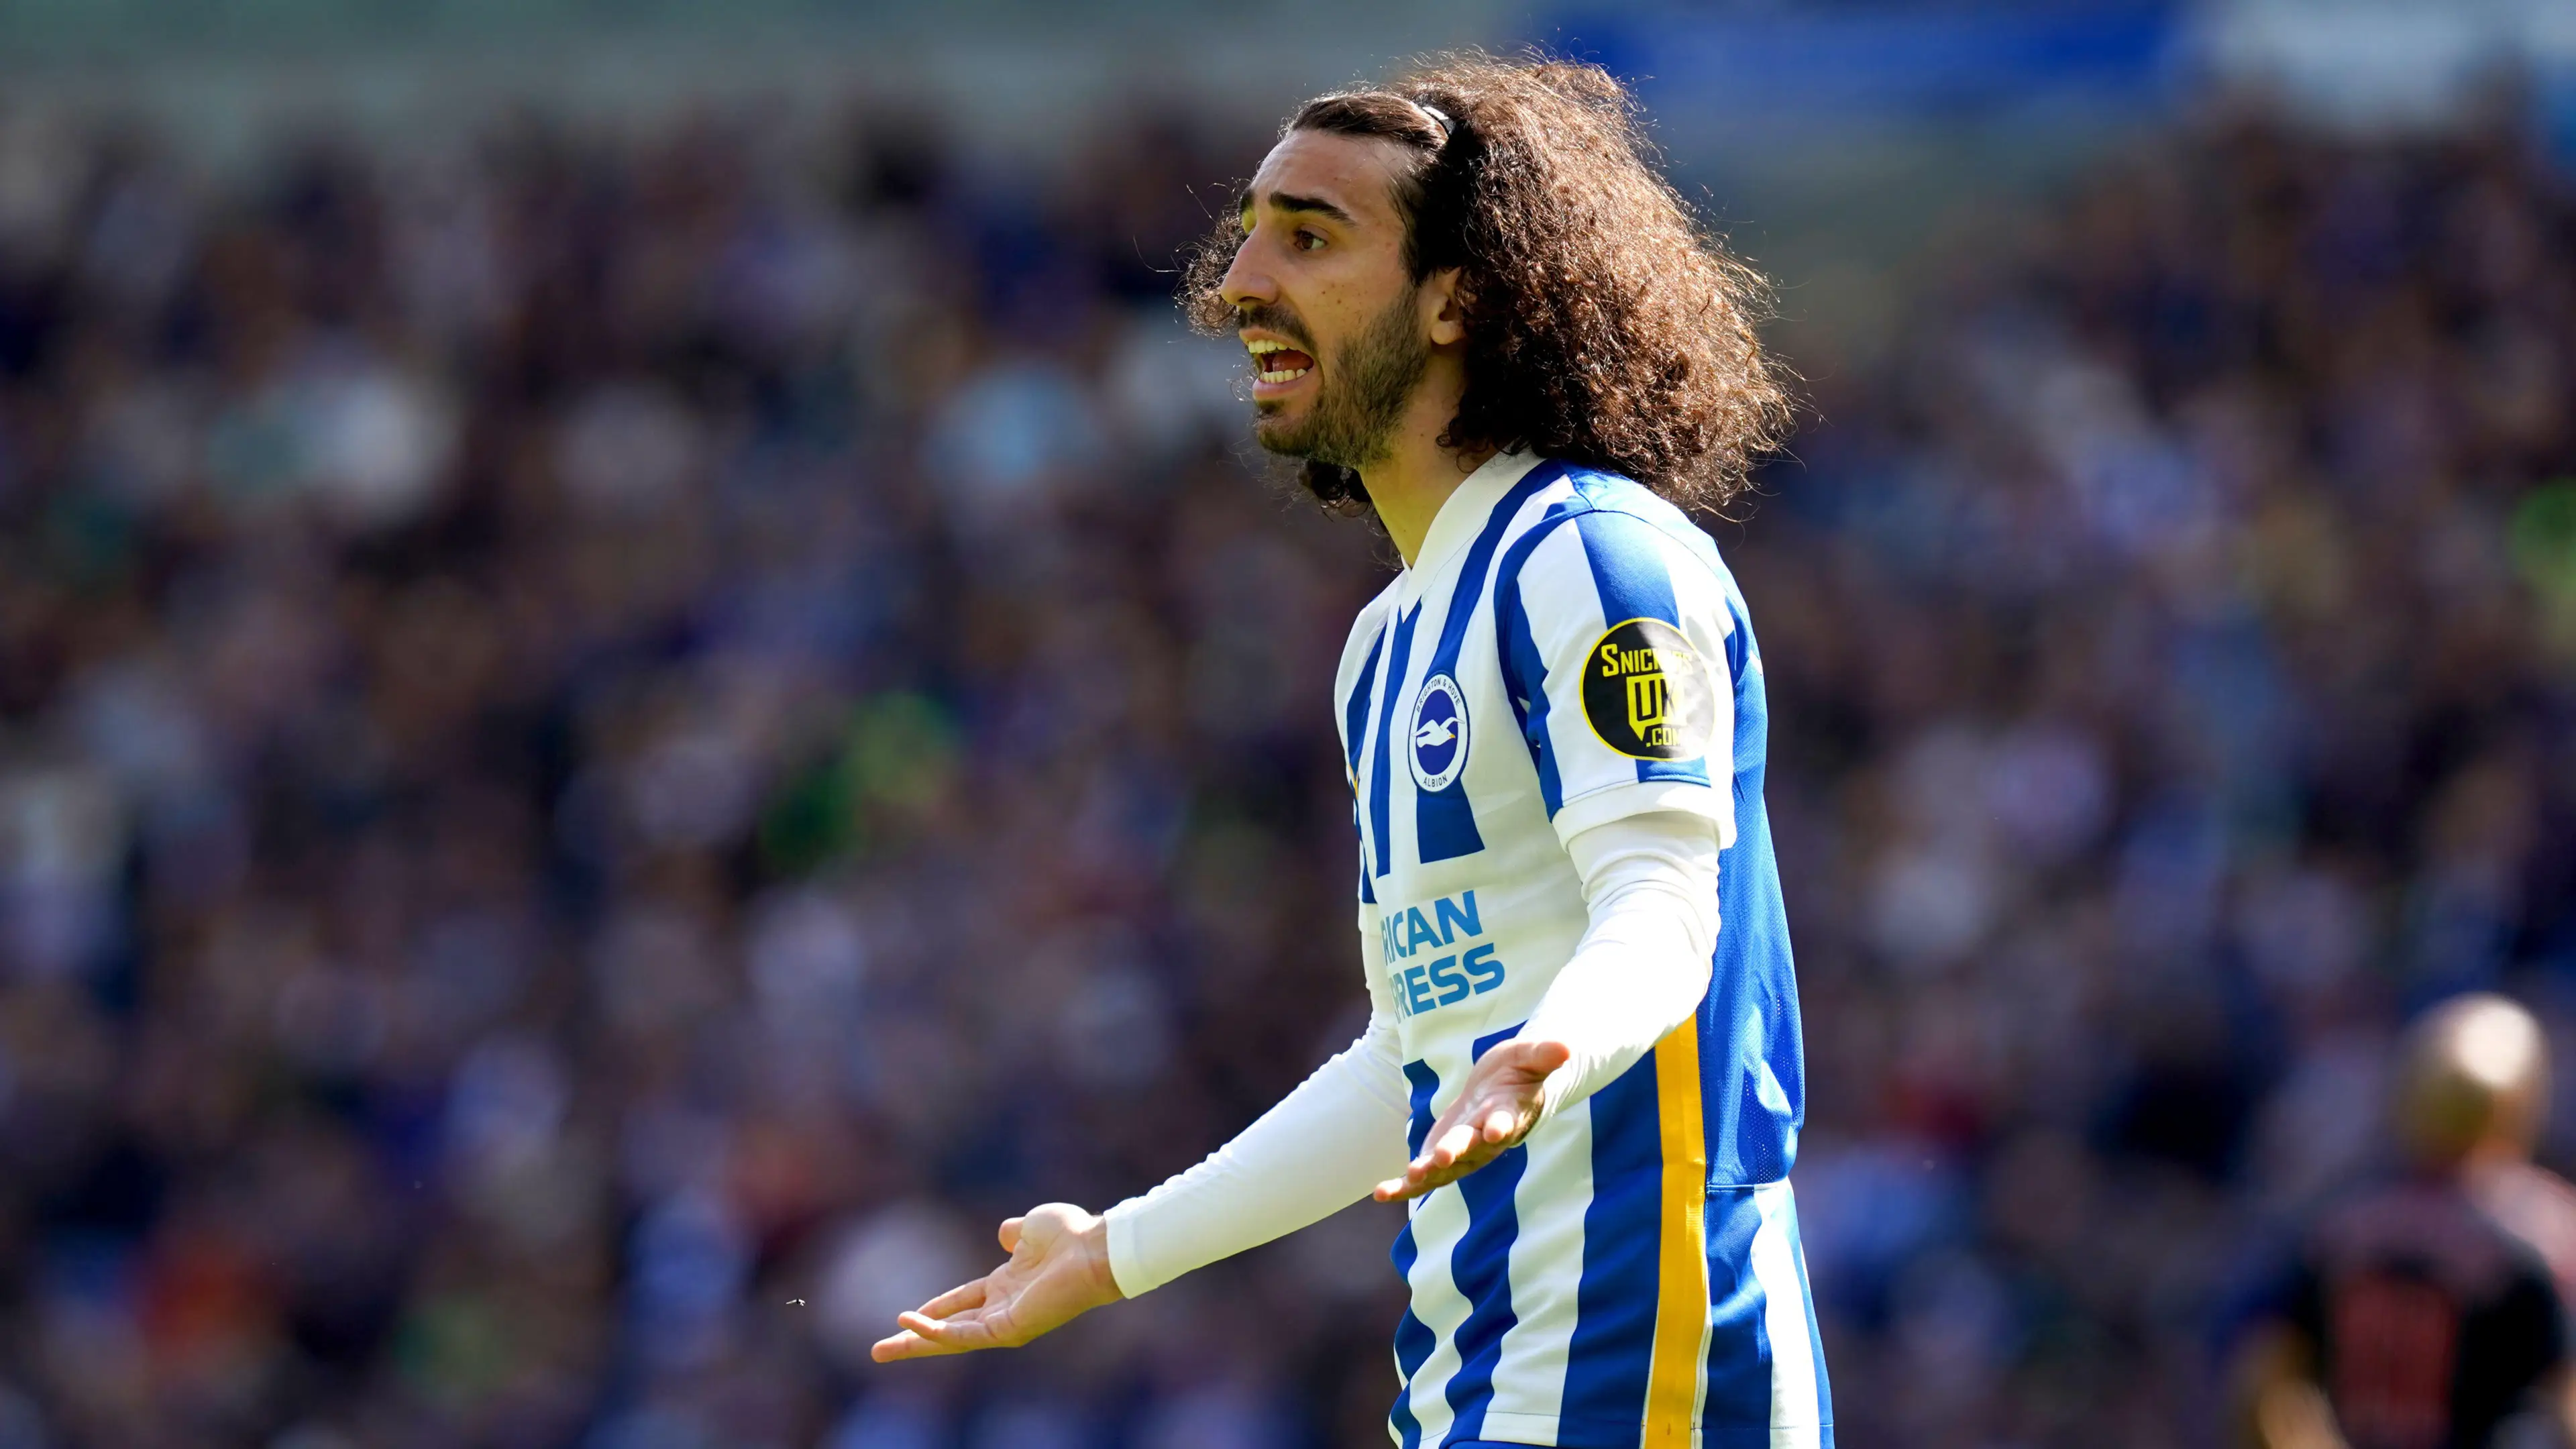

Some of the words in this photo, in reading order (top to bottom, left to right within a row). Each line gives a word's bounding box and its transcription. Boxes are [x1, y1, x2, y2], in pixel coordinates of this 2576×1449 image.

[1601, 643, 1693, 677] SNICRS
[1416, 677, 1441, 712] BRIGHTON
[1442, 678, 1447, 687] &
[1448, 683, 1461, 706] HOVE
[1423, 773, 1448, 788] ALBION
